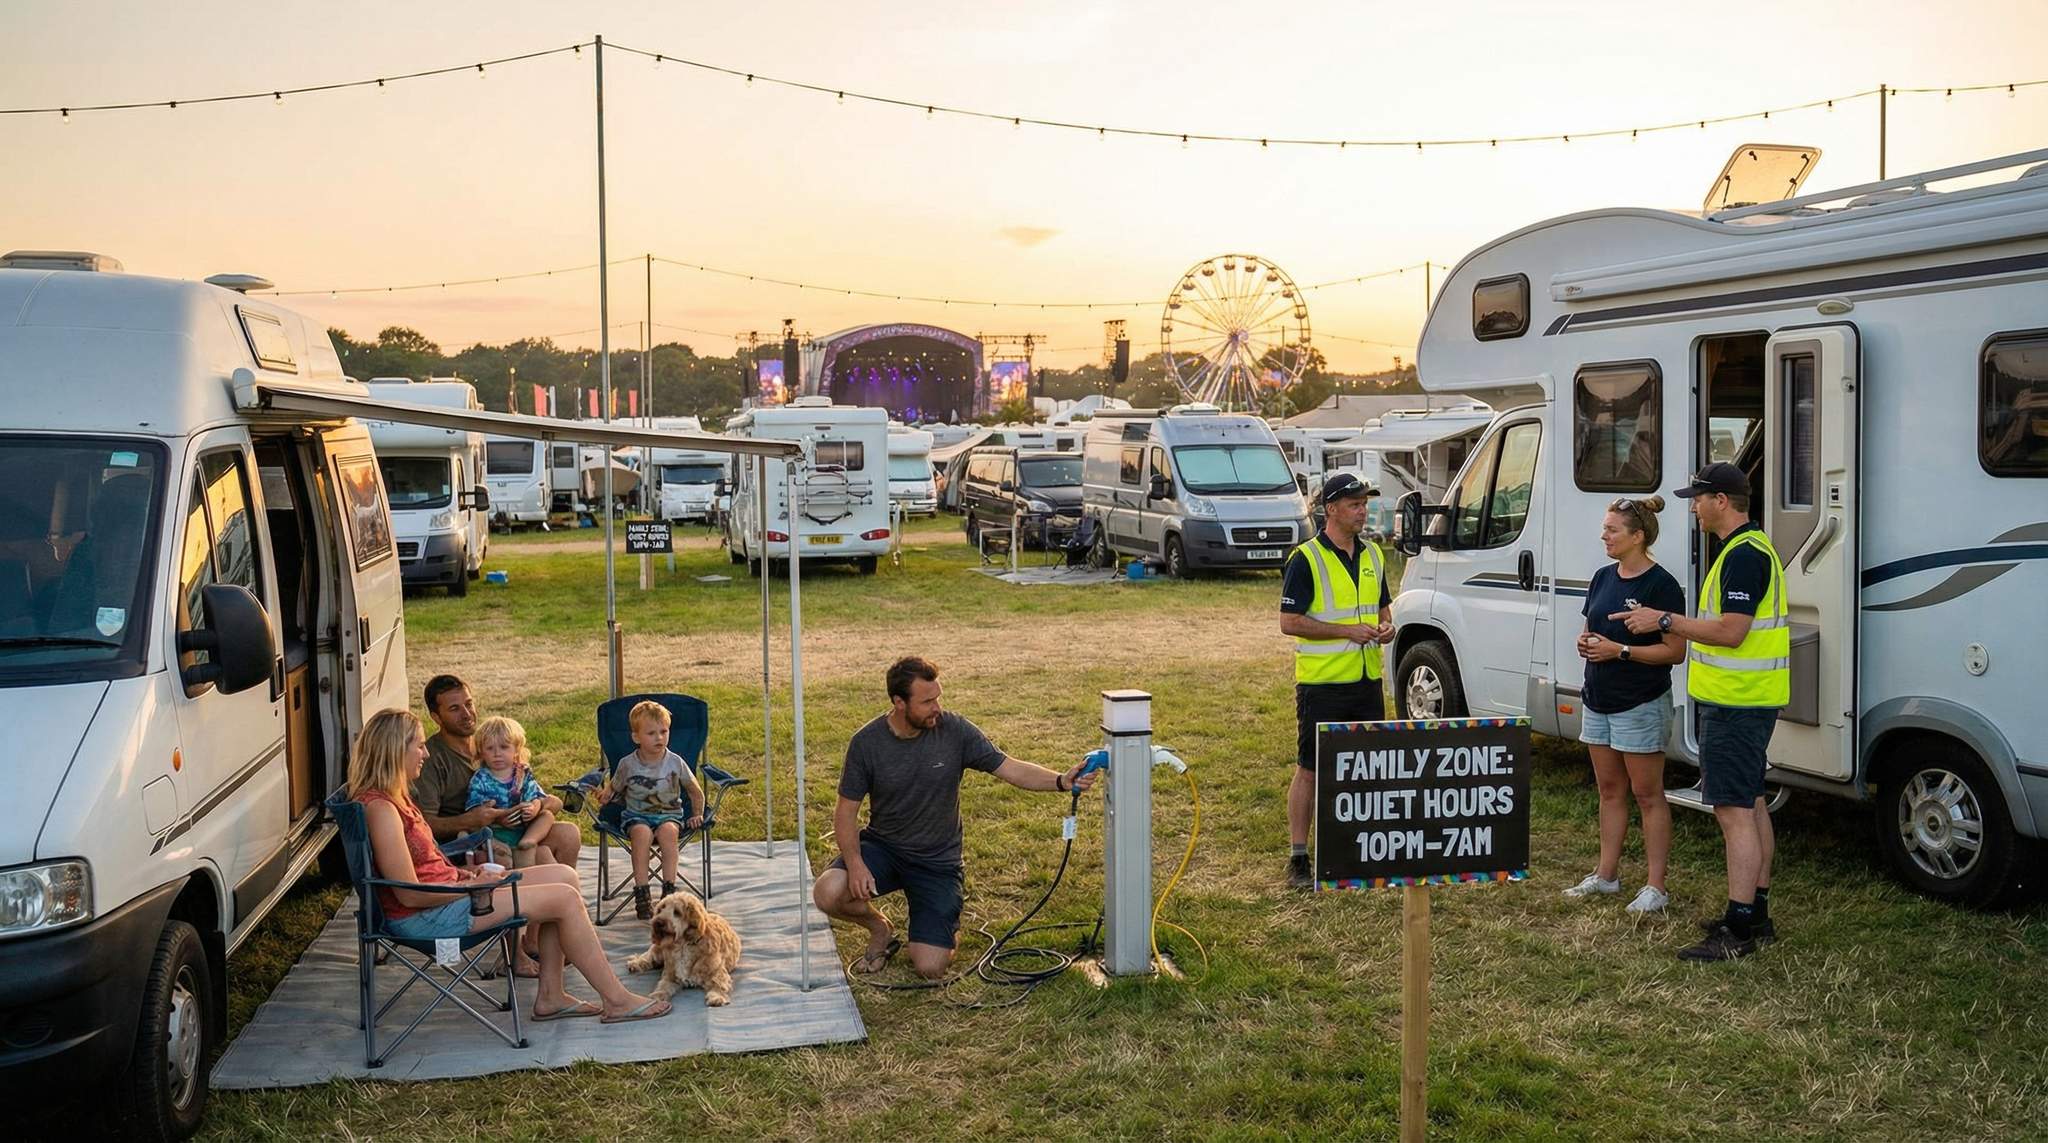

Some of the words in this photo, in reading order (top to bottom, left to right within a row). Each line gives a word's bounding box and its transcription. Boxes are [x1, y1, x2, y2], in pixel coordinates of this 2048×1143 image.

[1337, 749, 1430, 781] FAMILY
[1437, 746, 1513, 776] ZONE:
[1336, 790, 1416, 821] QUIET
[1424, 786, 1513, 818] HOURS
